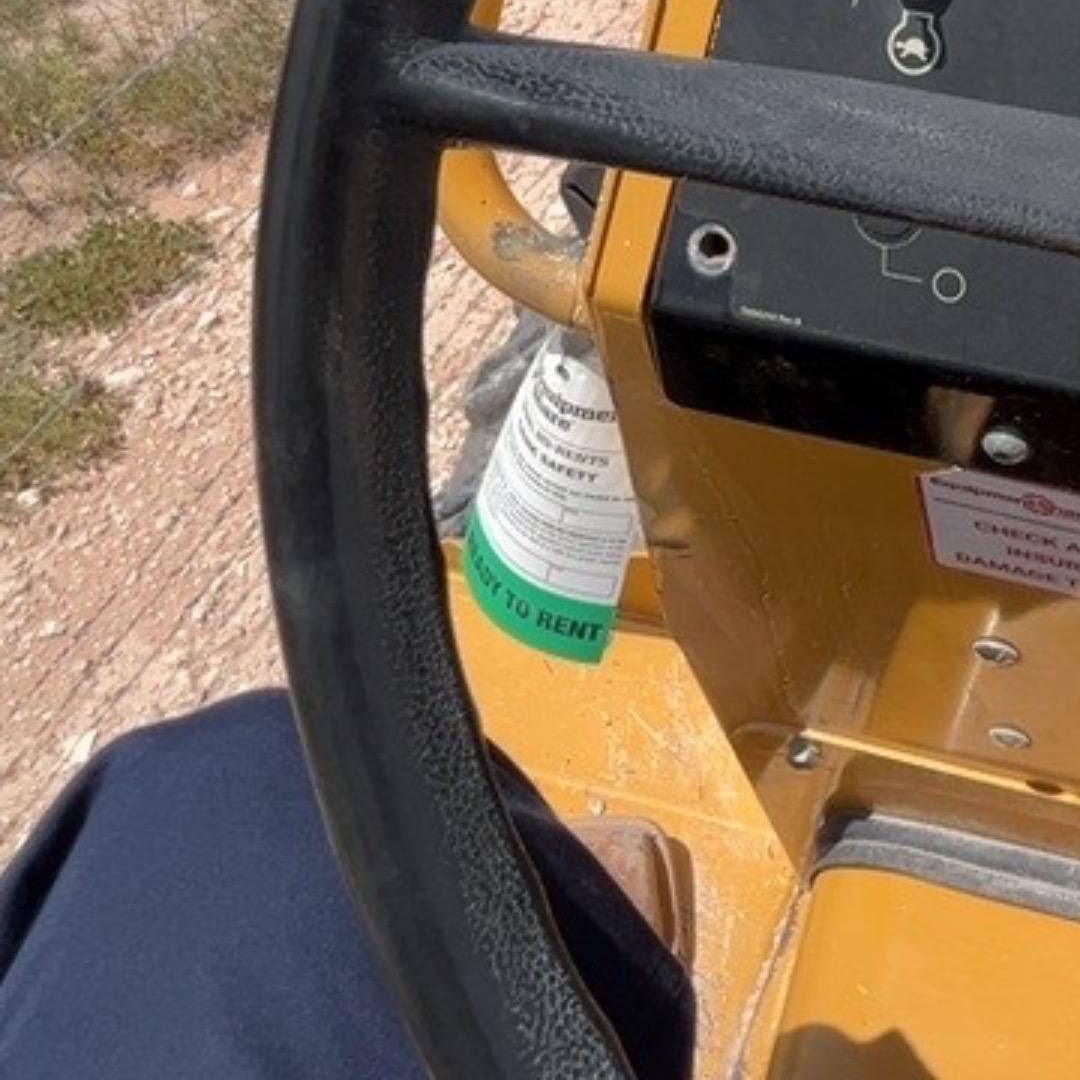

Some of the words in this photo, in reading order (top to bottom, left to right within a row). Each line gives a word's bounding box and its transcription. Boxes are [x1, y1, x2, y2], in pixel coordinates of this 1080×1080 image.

[973, 520, 1059, 550] CHECK
[954, 550, 1059, 584] DAMAGE
[505, 587, 530, 619] TO
[535, 607, 604, 642] RENT
